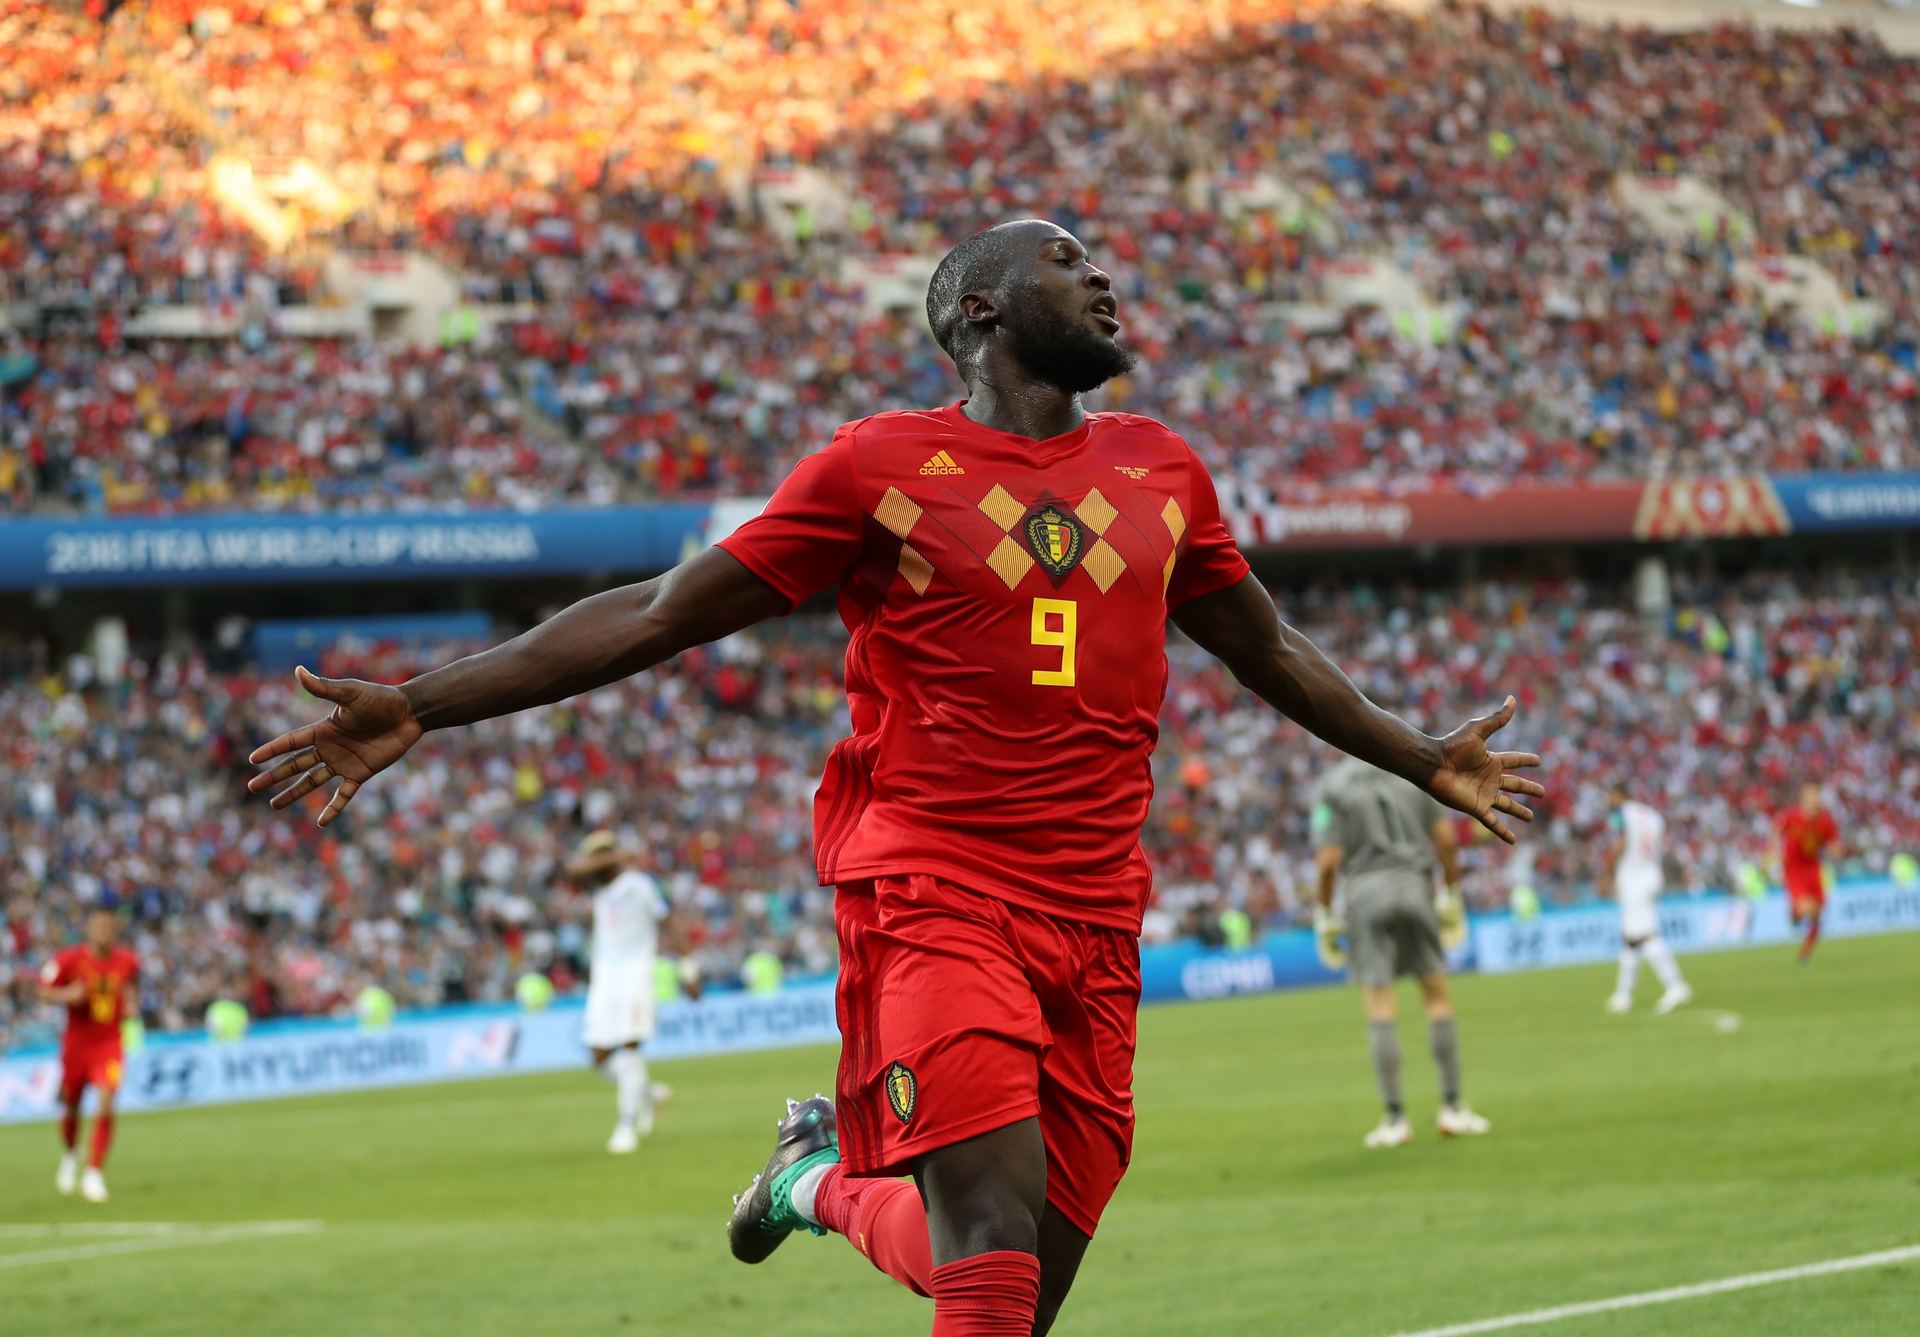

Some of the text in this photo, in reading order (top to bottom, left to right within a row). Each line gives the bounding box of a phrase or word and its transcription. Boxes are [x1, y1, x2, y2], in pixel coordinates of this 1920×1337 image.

[919, 466, 965, 475] adidas
[46, 522, 539, 574] 2018 FIFA WORLD CUP RUSSIA
[1031, 598, 1078, 687] 9
[222, 1035, 429, 1085] HYUNDAI
